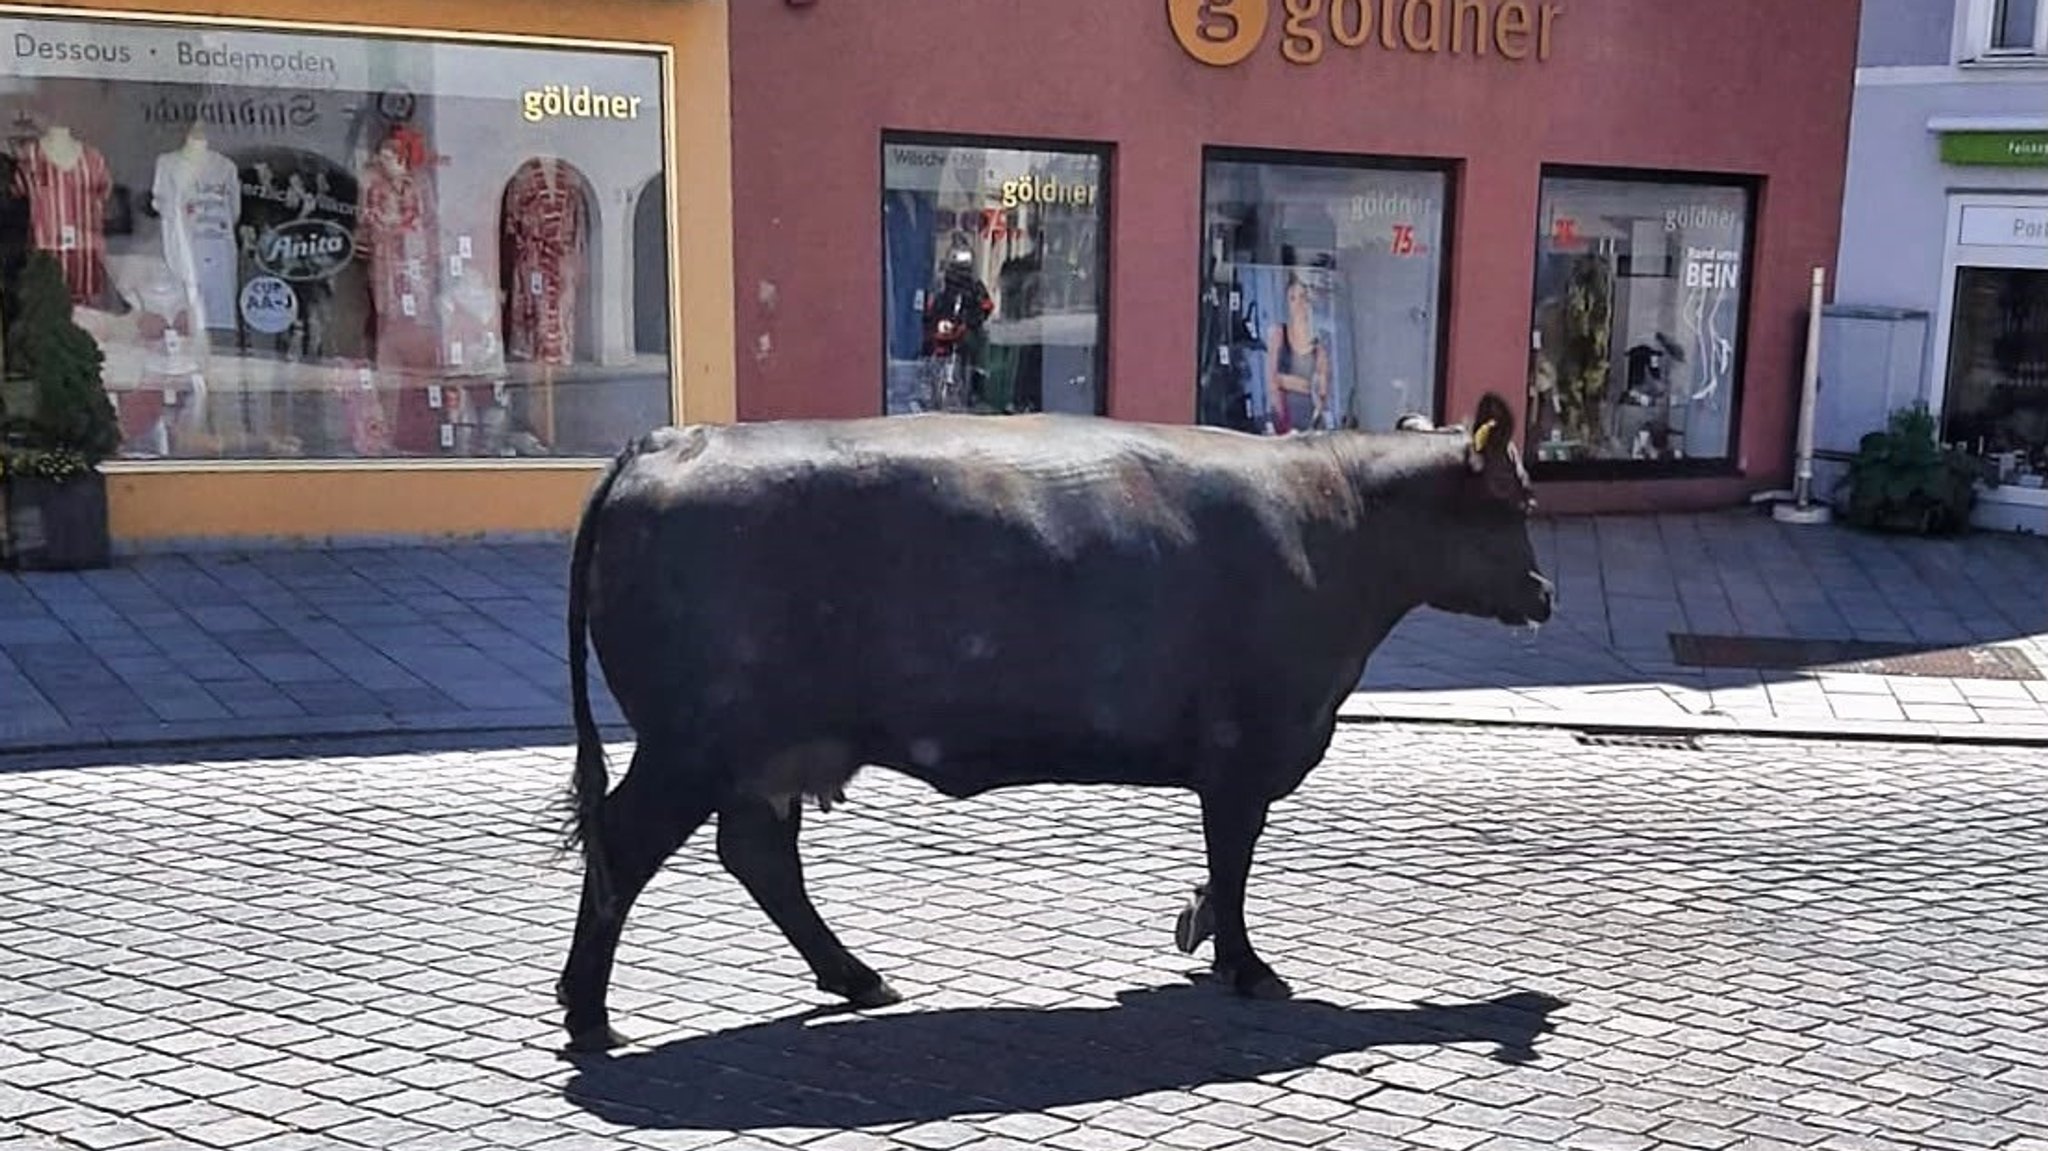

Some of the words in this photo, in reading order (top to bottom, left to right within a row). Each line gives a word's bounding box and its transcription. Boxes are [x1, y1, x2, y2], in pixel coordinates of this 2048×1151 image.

[14, 33, 131, 63] Dessous
[176, 42, 336, 74] Bademoden
[522, 86, 641, 121] göldner
[1002, 175, 1098, 207] göldner
[1350, 191, 1431, 221] göldner
[1664, 205, 1735, 232] göldner
[264, 232, 344, 262] Anita
[1391, 224, 1414, 255] 75
[252, 281, 282, 294] CUP
[1686, 262, 1737, 288] BEIN
[247, 295, 293, 310] AA-J
